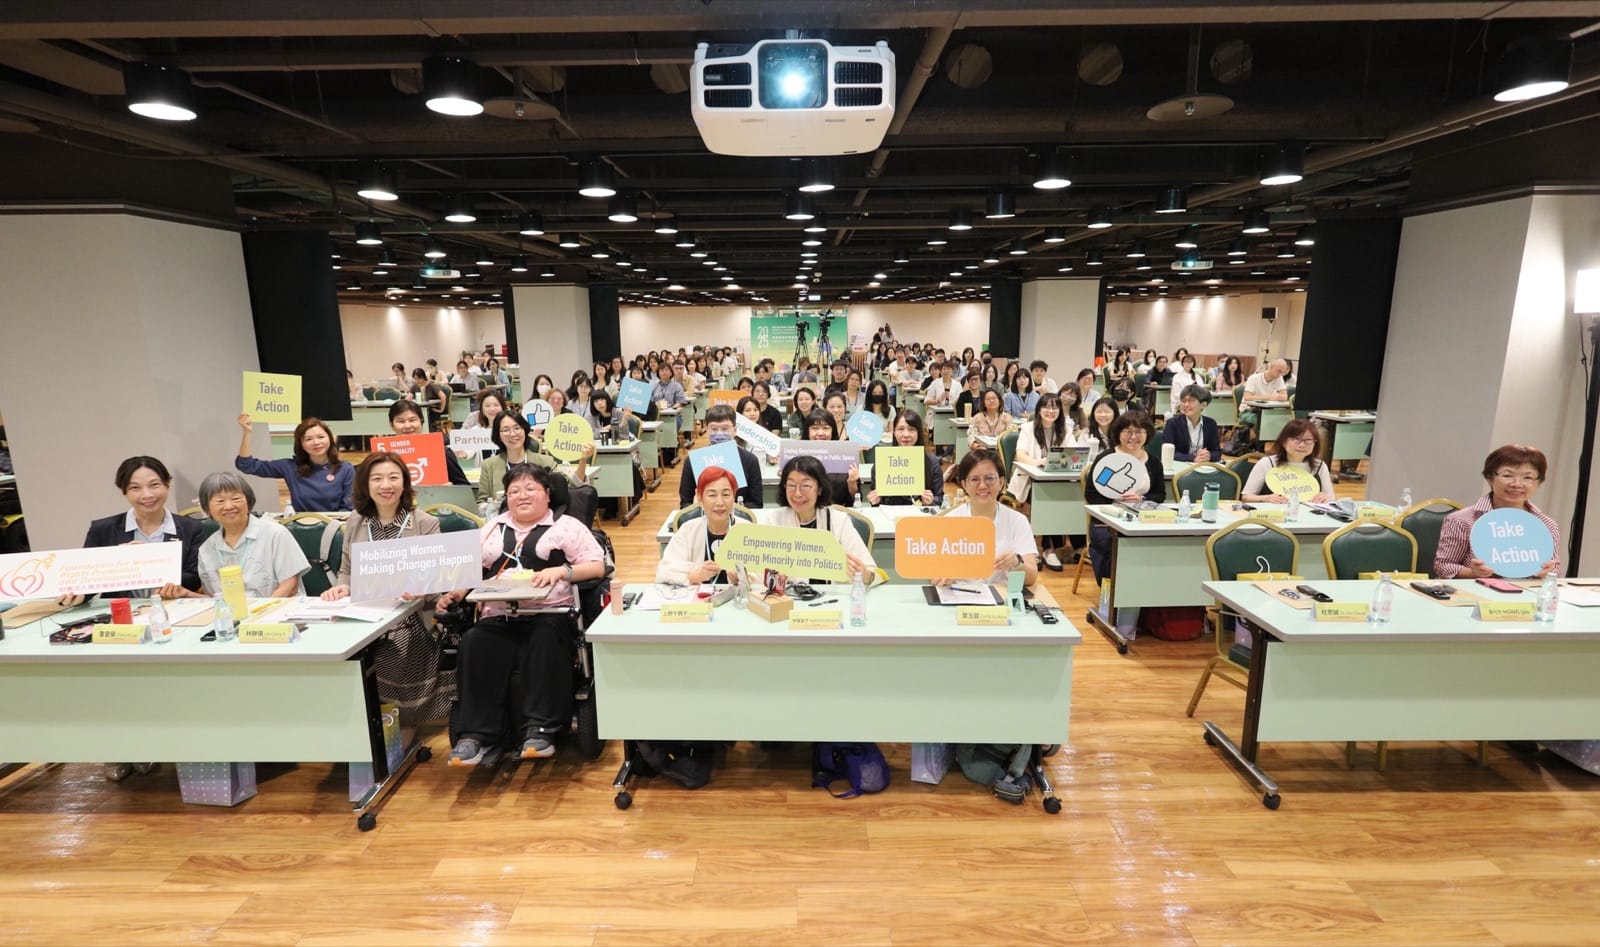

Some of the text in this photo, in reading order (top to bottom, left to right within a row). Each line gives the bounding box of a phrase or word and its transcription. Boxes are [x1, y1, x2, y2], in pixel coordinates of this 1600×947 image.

[258, 382, 284, 395] Take
[629, 384, 643, 394] Take
[255, 399, 290, 413] Action
[558, 422, 579, 435] Take
[862, 415, 875, 429] Take
[454, 436, 490, 445] Partne
[736, 422, 777, 450] eadership
[376, 441, 387, 453] 5
[390, 440, 411, 448] GENDER
[553, 439, 583, 452] Action
[704, 454, 725, 467] Take
[888, 455, 910, 468] Take
[886, 473, 915, 486] Action
[1273, 472, 1298, 482] Take
[1487, 520, 1525, 538] Take
[743, 536, 792, 553] Empowering
[904, 537, 985, 555] Take Action
[360, 548, 408, 562] Mobilizing
[727, 550, 843, 572] Bringing Minority into Politics
[1492, 546, 1540, 564] Action
[359, 553, 474, 576] Making Changes Happen
